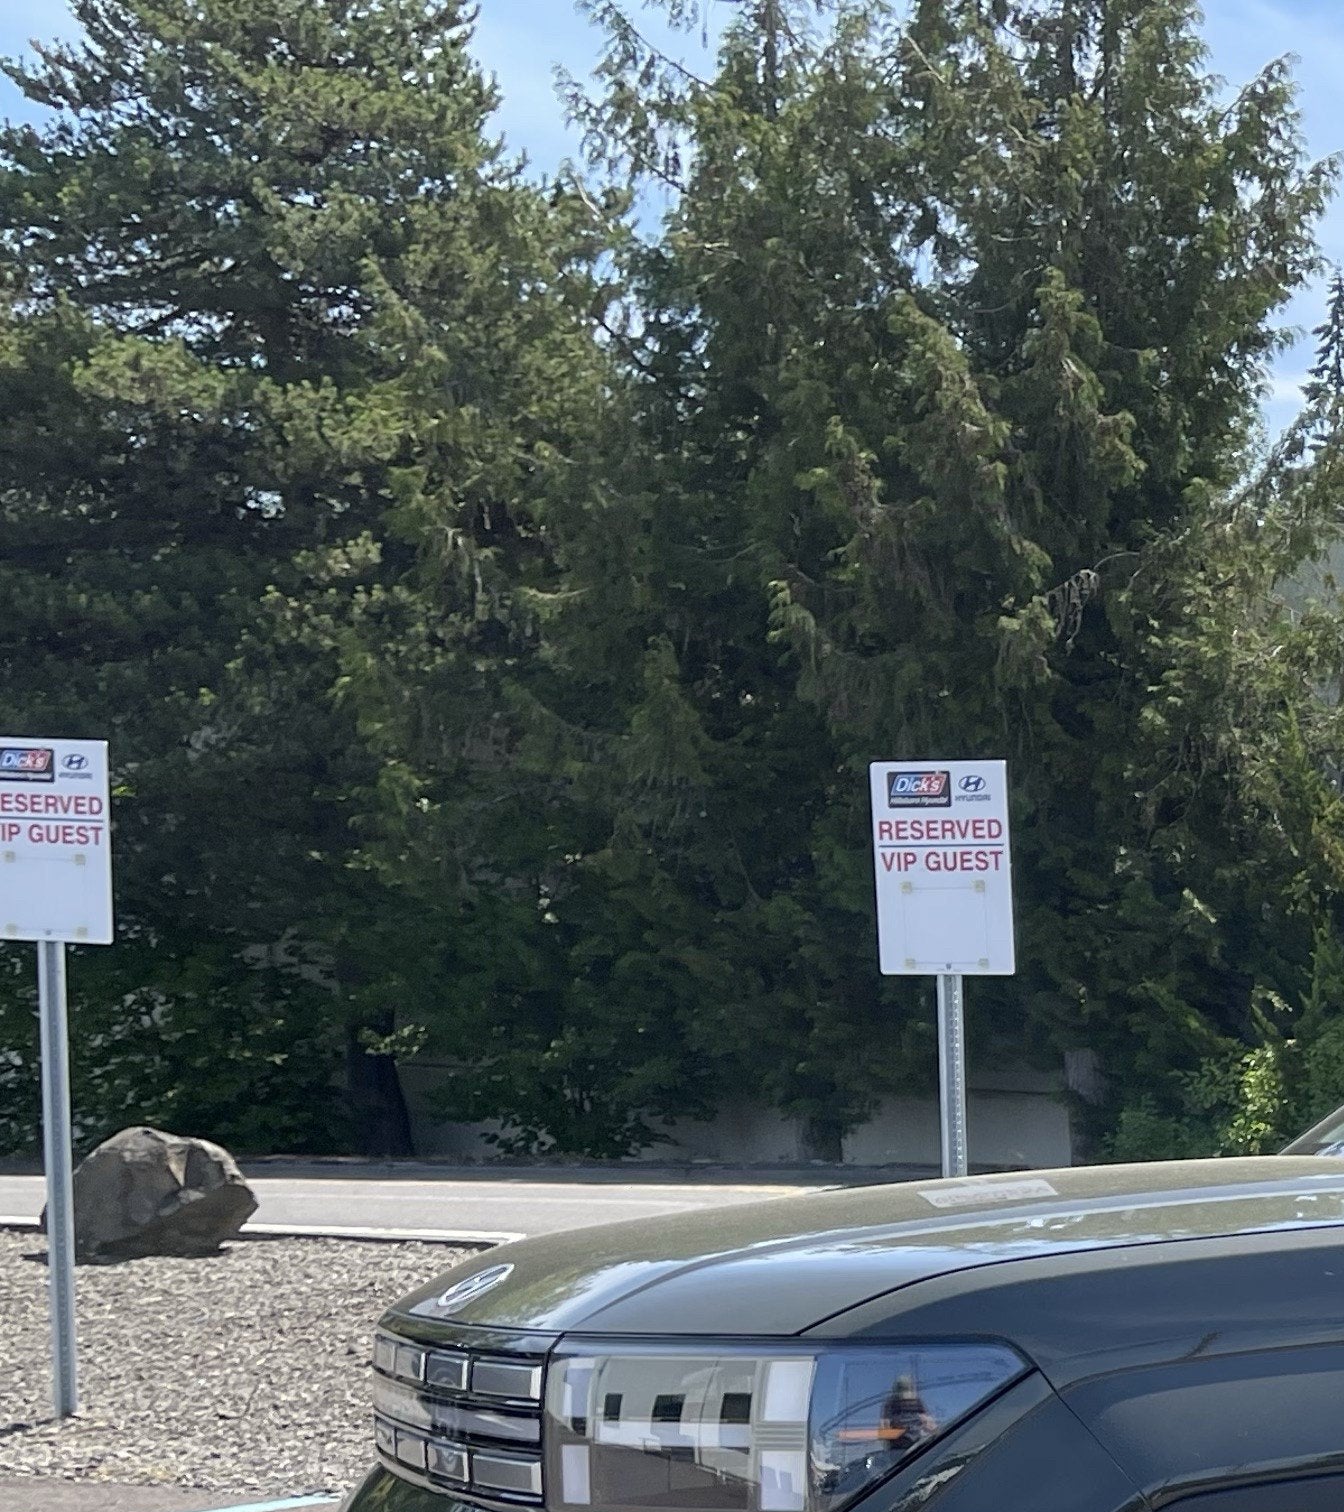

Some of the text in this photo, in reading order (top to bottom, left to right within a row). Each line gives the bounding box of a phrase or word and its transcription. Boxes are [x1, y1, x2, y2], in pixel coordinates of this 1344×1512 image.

[0, 793, 103, 815] ESERVED
[0, 822, 104, 846] IP GUEST
[878, 818, 1003, 841] RESERVED
[881, 850, 1003, 872] VIP GUEST
